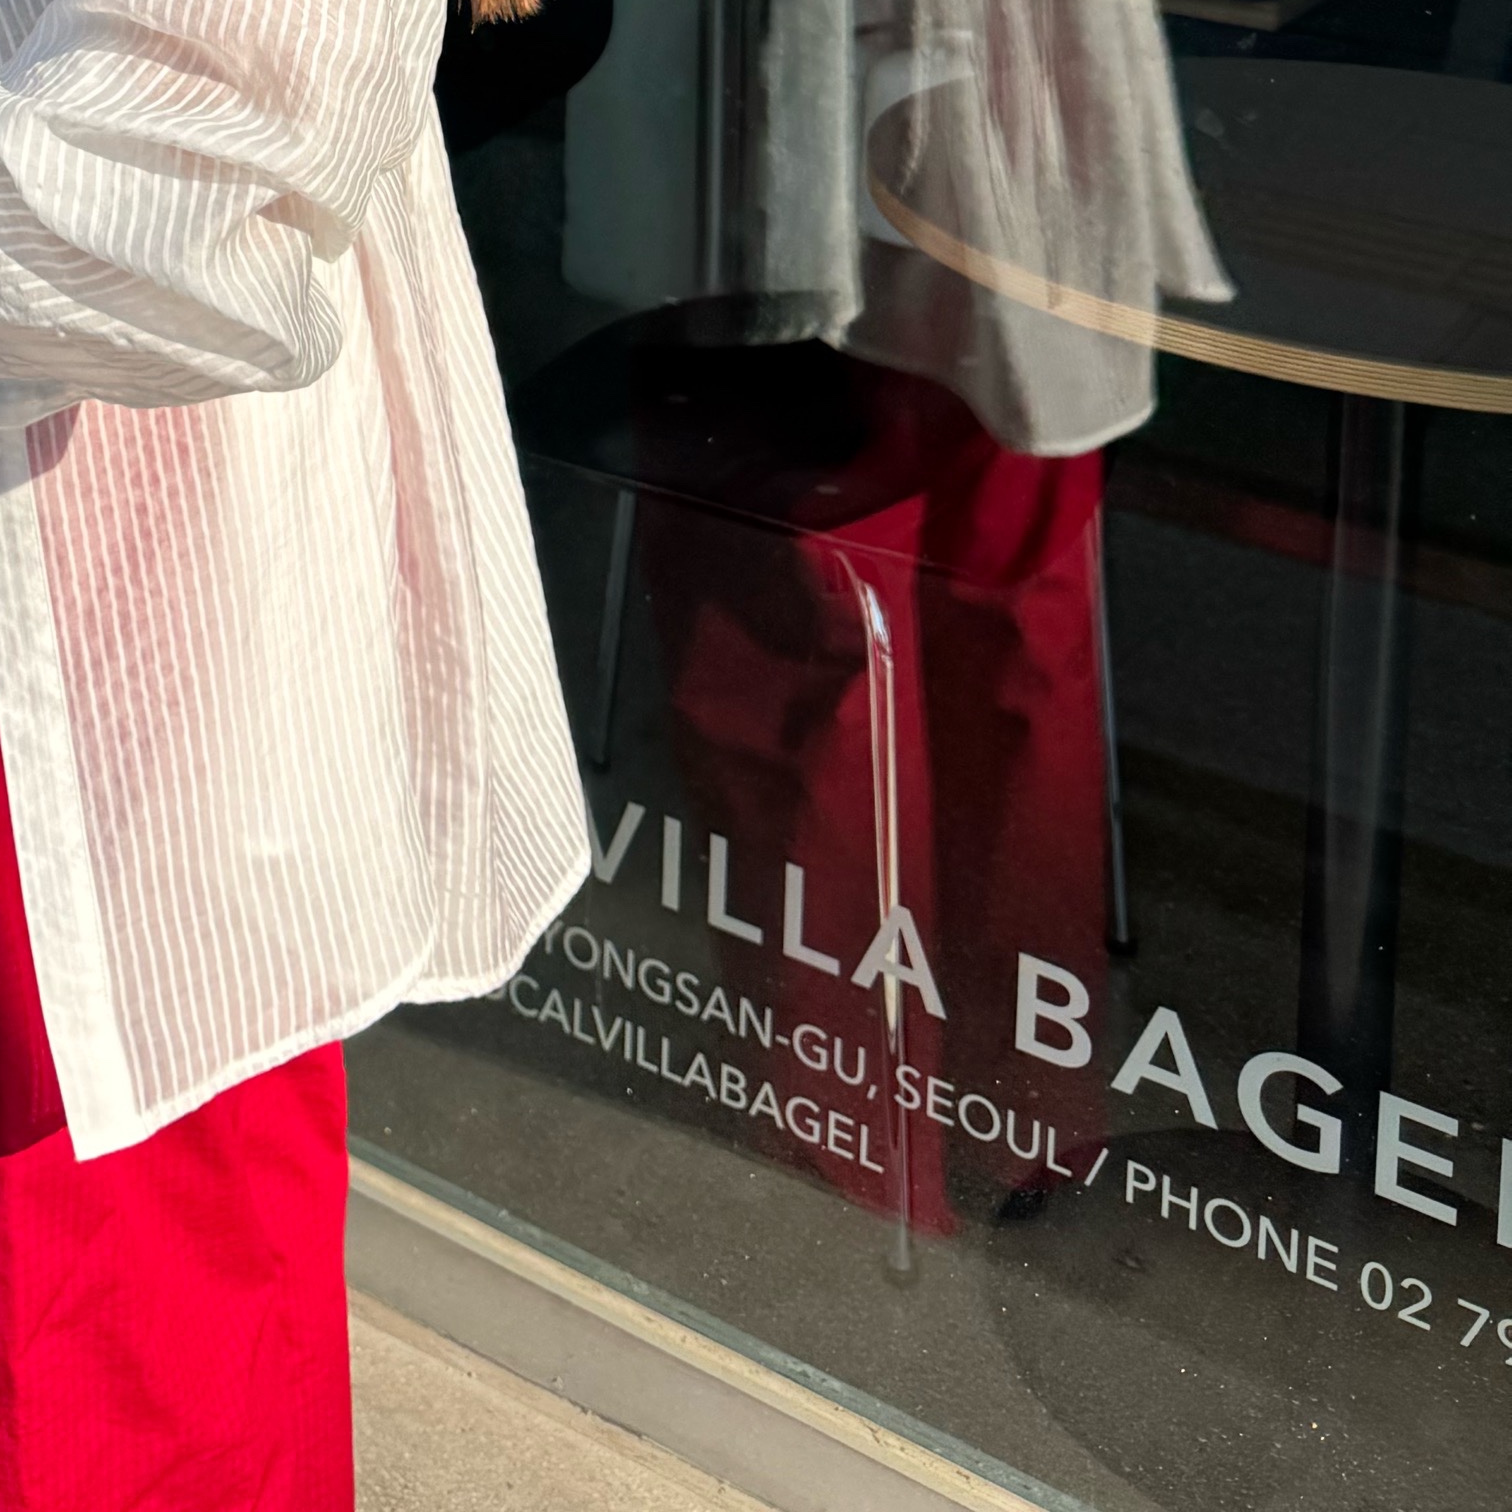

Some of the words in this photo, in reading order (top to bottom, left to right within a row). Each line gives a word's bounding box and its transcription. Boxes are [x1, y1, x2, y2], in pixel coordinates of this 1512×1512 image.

[588, 801, 947, 1020] VILLA
[488, 974, 885, 1175] CALVILLABAGEL
[894, 1063, 1073, 1178] SEOUL
[1084, 1147, 1109, 1187] /
[1124, 1159, 1340, 1292] PHONE
[1360, 1260, 1432, 1332] 02
